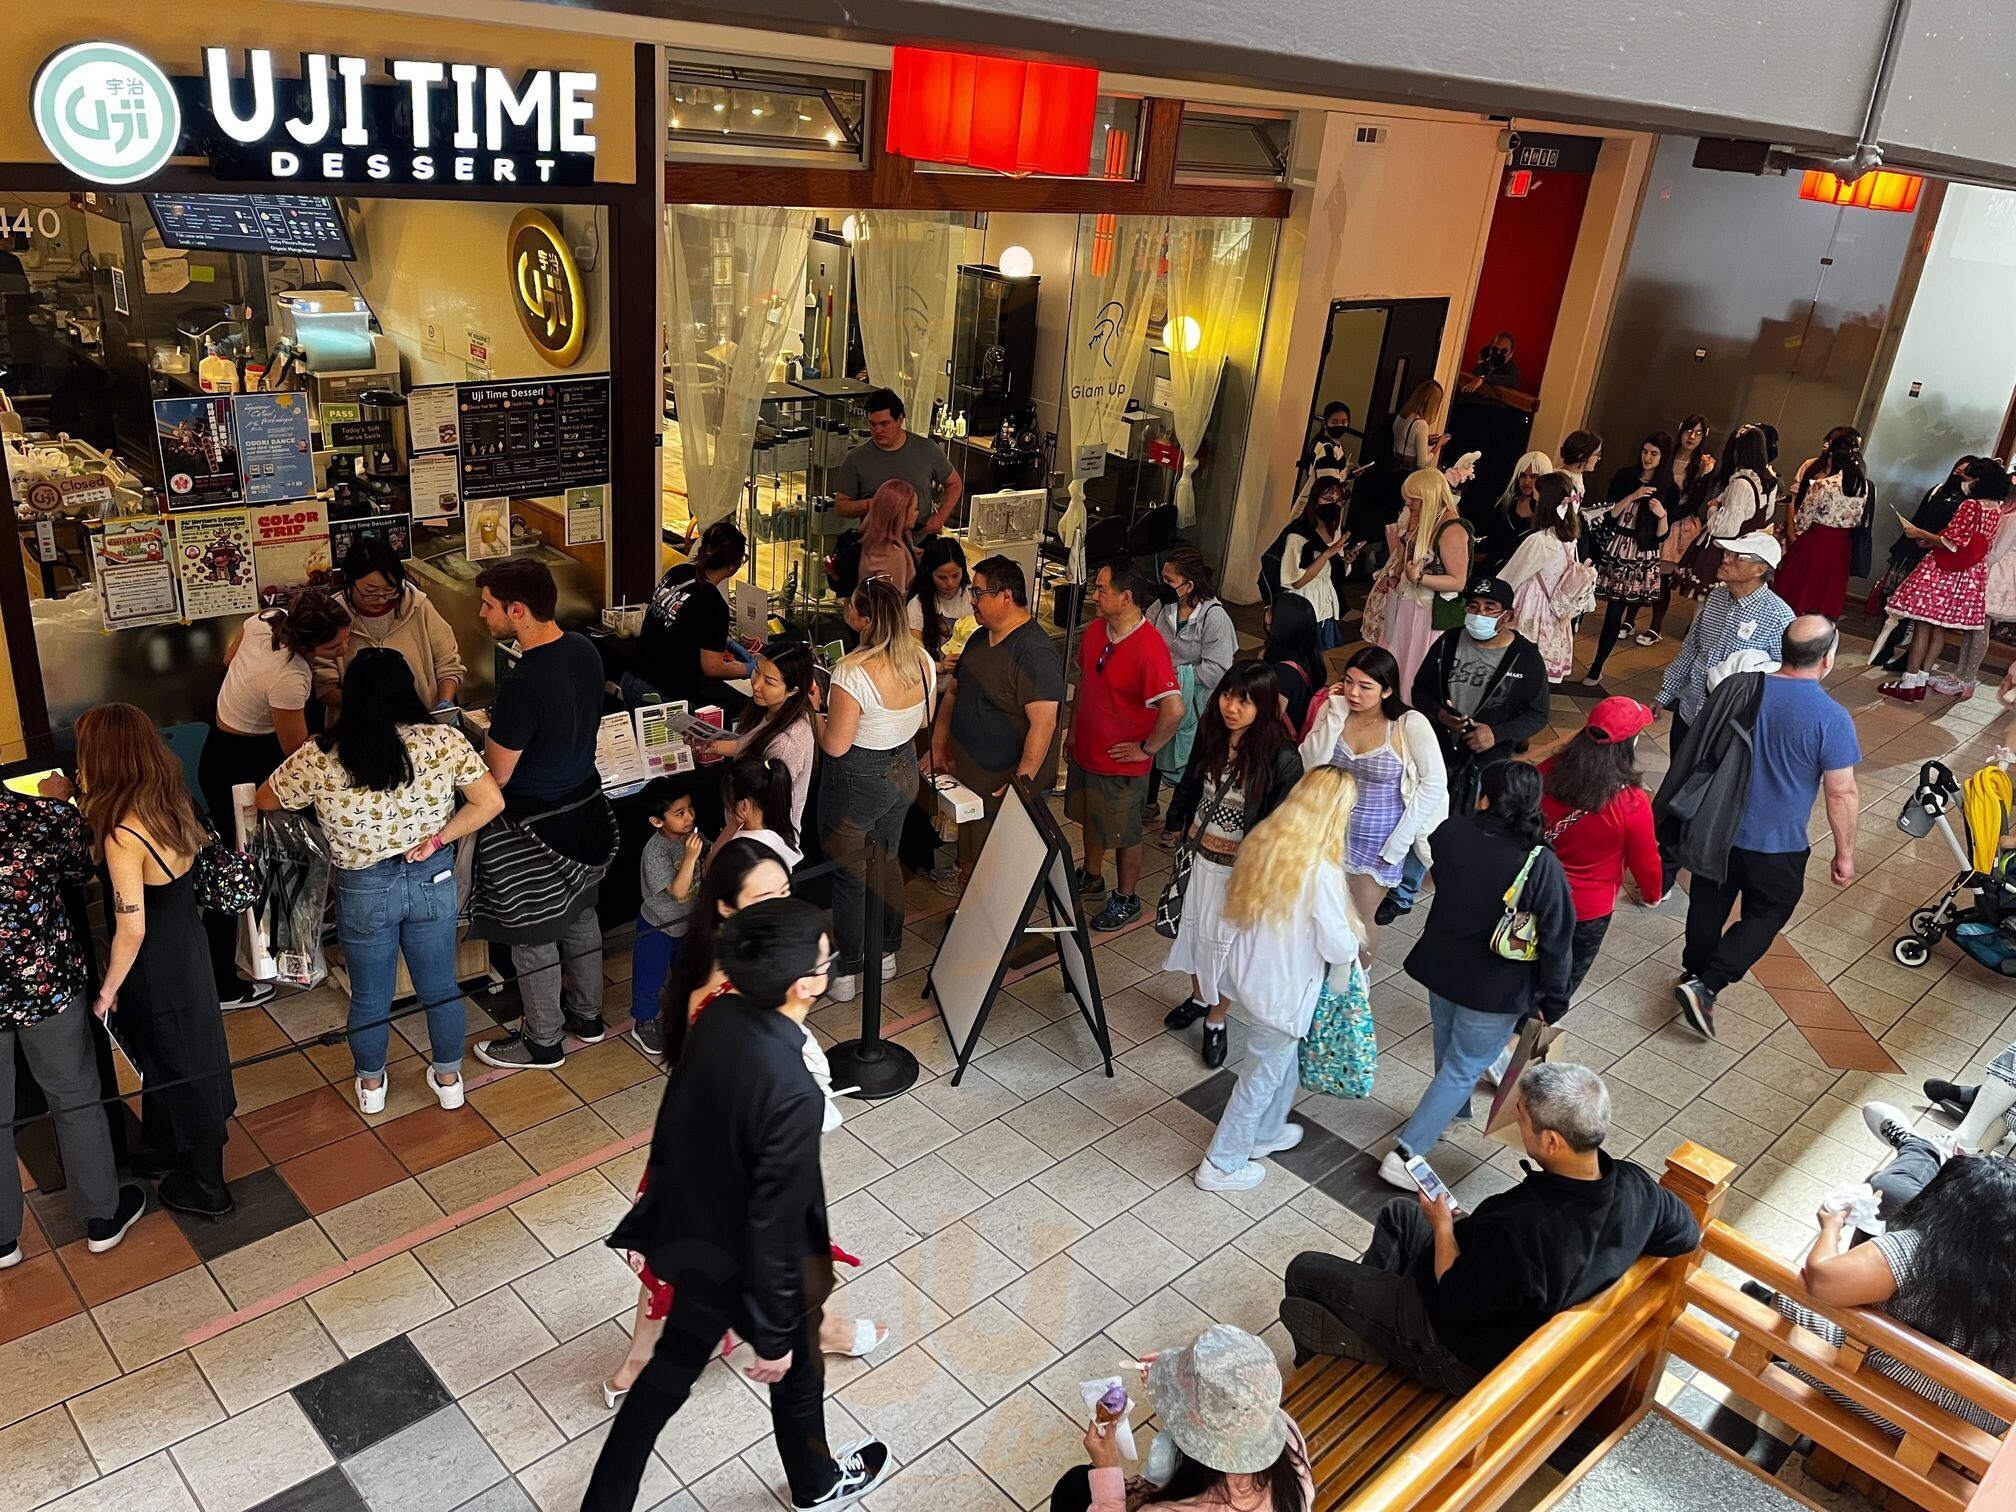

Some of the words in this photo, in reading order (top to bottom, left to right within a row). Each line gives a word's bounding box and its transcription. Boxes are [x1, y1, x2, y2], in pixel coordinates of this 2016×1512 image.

[106, 77, 146, 97] 宇治
[206, 47, 368, 146] UJI
[394, 60, 597, 152] TIME
[271, 151, 556, 183] DESSERT
[471, 390, 484, 402] Uji
[485, 389, 508, 400] Time
[511, 387, 545, 399] Dessert
[1071, 385, 1104, 399] Glam
[1108, 381, 1125, 398] Up
[329, 410, 354, 418] PASS
[271, 437, 296, 445] DANCE
[60, 476, 105, 492] Closed
[258, 511, 319, 527] COLOR
[260, 524, 305, 539] TRIP
[1506, 671, 1524, 679] MARS
